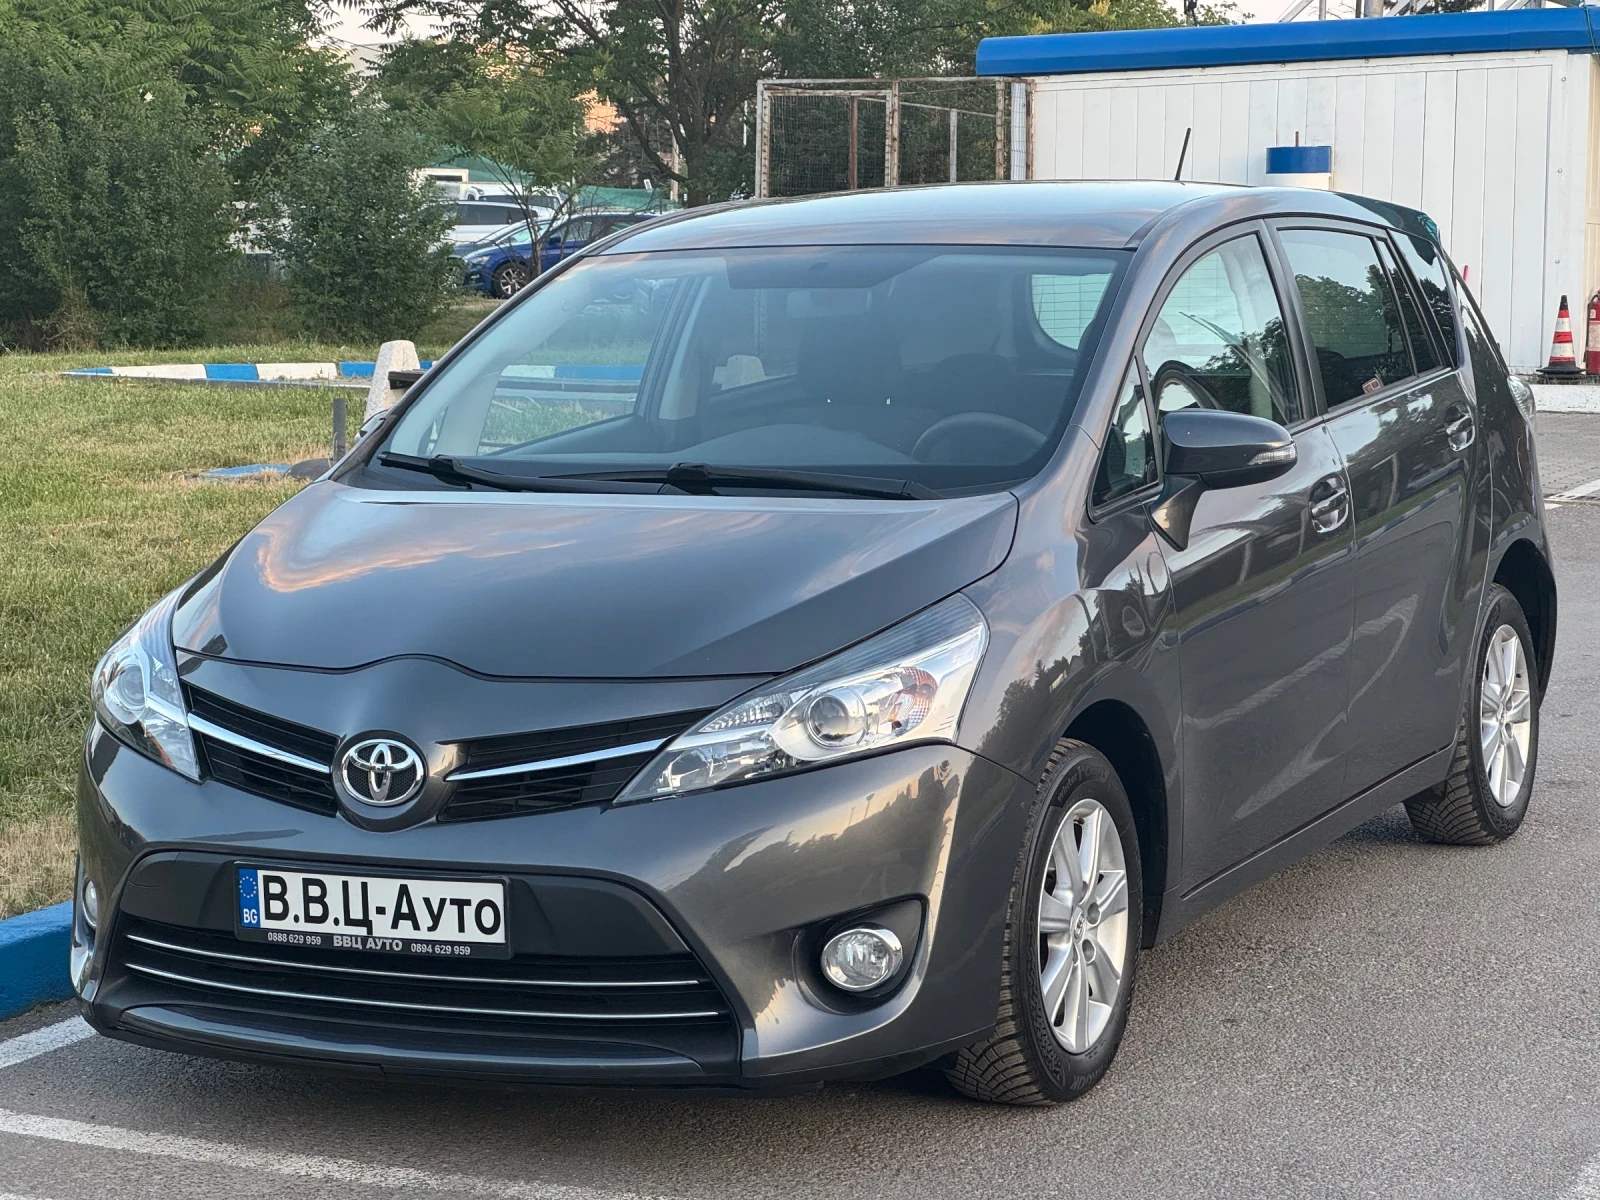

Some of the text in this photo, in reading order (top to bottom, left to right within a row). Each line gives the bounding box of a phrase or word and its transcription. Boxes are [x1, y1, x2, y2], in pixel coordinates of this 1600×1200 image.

[243, 908, 258, 924] BG
[267, 932, 471, 955] 0888 629 959 ВВЦ АУТО 0894 629 959
